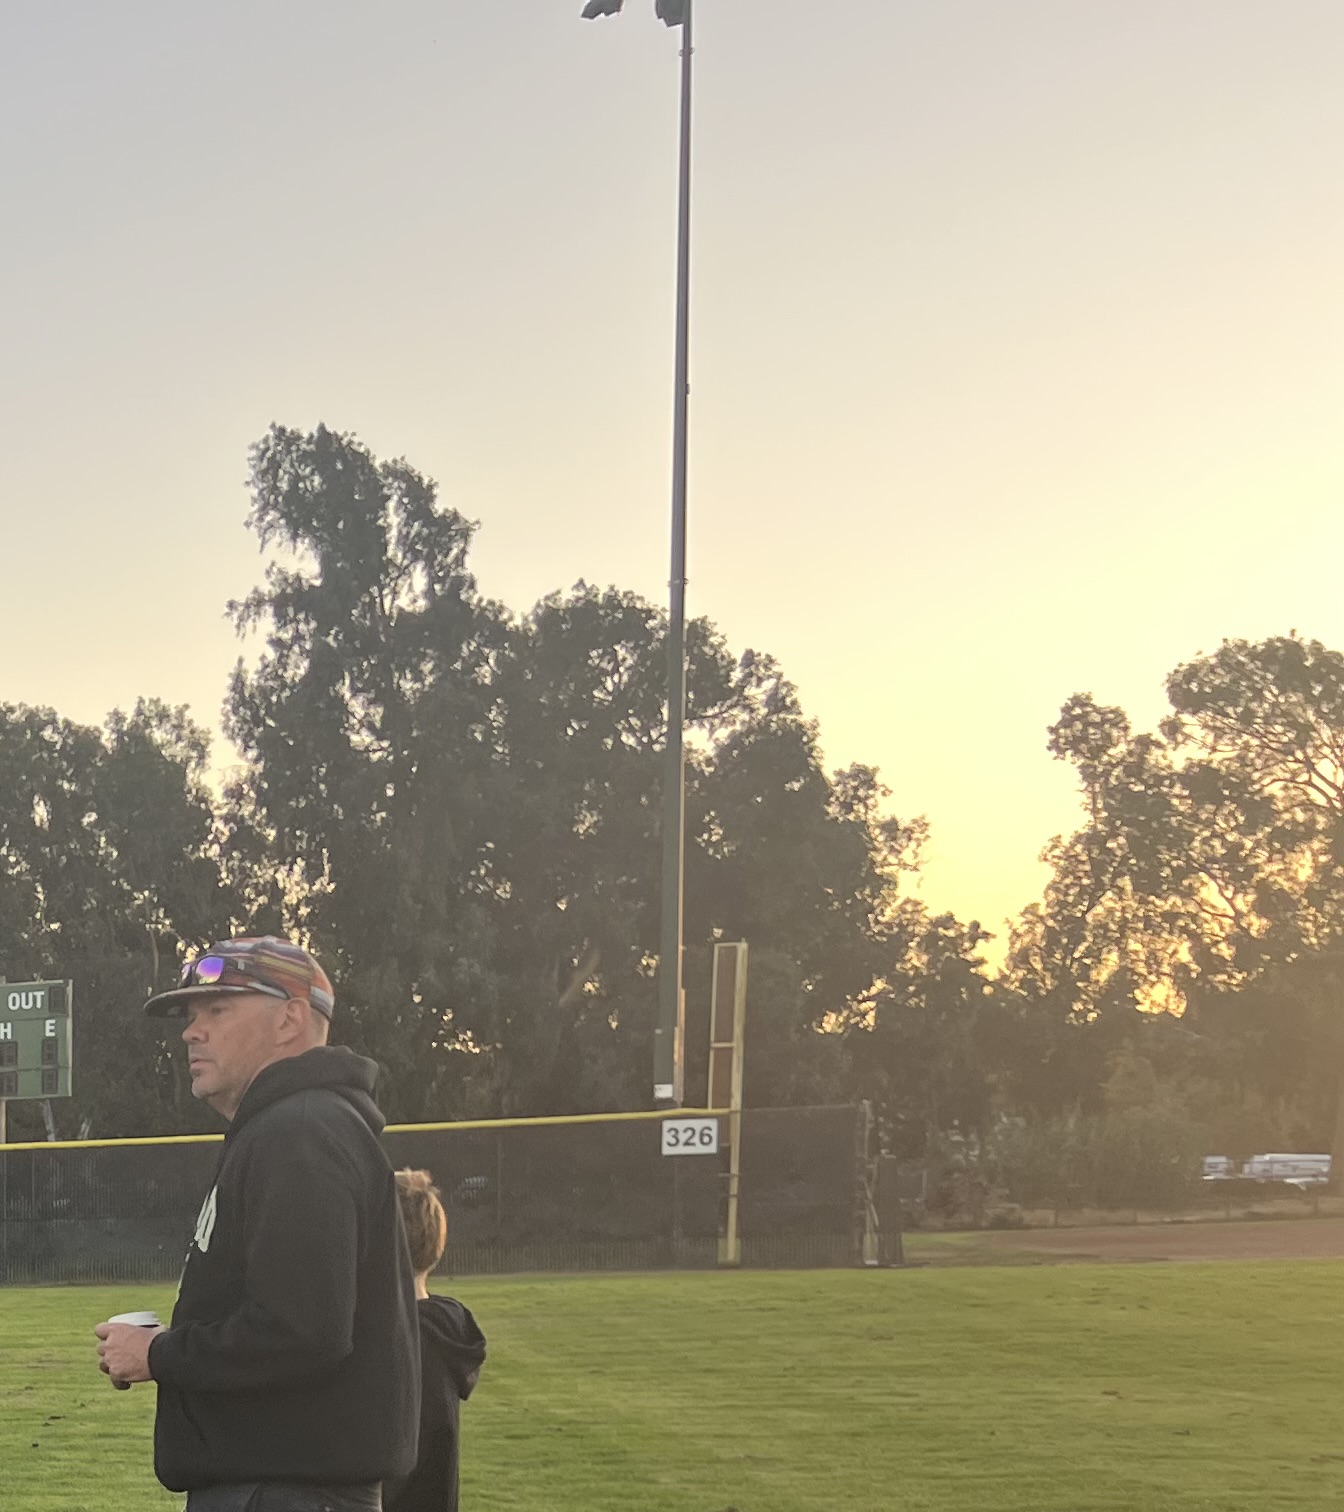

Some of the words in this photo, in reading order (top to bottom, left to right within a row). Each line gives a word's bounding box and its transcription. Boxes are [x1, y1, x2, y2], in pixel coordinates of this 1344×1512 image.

[7, 991, 45, 1011] OUT
[0, 1022, 12, 1040] H
[44, 1019, 56, 1037] E
[666, 1126, 713, 1147] 326
